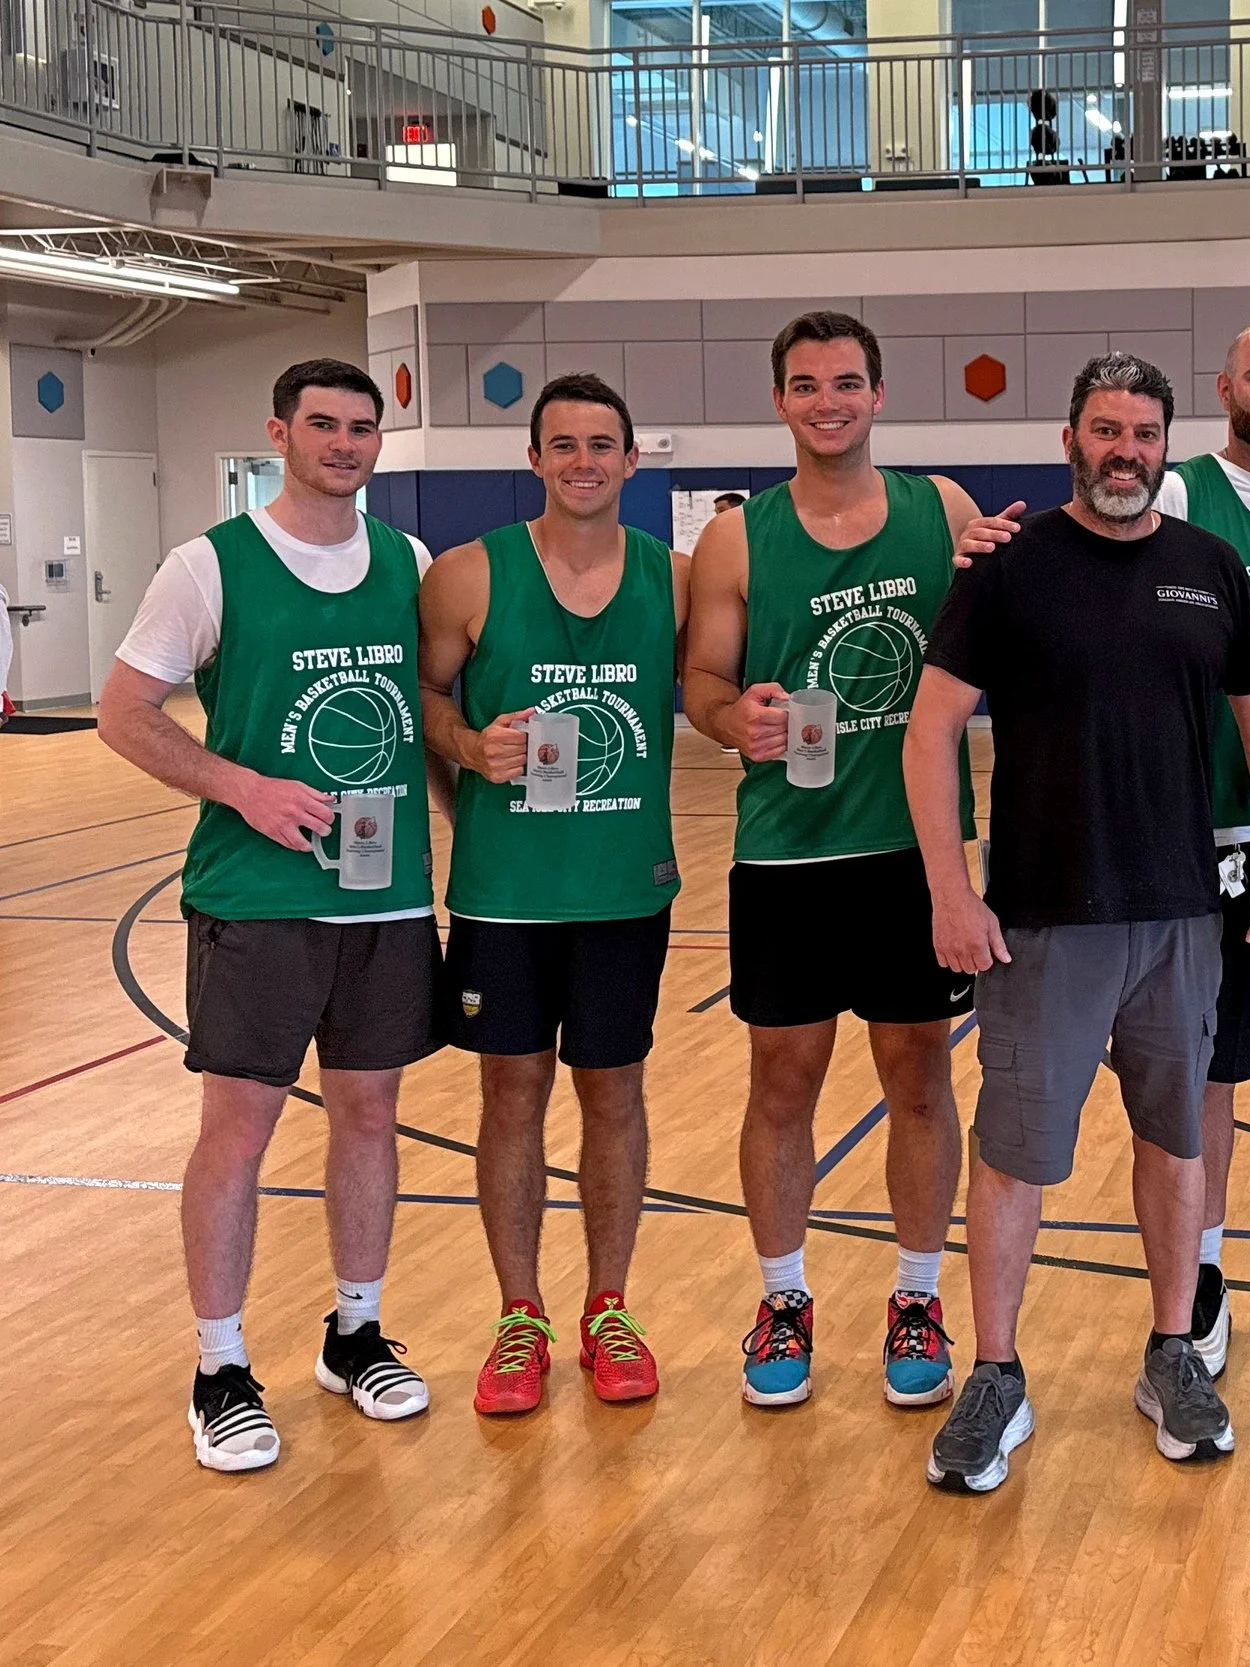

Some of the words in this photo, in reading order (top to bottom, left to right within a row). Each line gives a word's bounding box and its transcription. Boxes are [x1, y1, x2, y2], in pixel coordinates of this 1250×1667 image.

[810, 586, 865, 616] STEVE
[868, 576, 917, 602] LIBRO
[292, 647, 352, 671] STEVE
[355, 645, 403, 666] LIBRO
[807, 650, 824, 690] MEN'S
[818, 605, 883, 650] BASKETBALL
[886, 606, 929, 656] TOURNAM
[531, 664, 586, 683] STEVE
[591, 664, 637, 682] LIBRO
[280, 711, 303, 753] MEN'S
[295, 670, 370, 712] BASKETBALL
[374, 672, 414, 743] TOURNAMENT
[535, 687, 599, 714] ASKETBALL
[602, 690, 647, 758] TOURNAMENT
[836, 720, 858, 735] ISLE
[860, 716, 882, 731] CITY
[884, 711, 910, 727] RECRE
[582, 798, 641, 812] RECREATION
